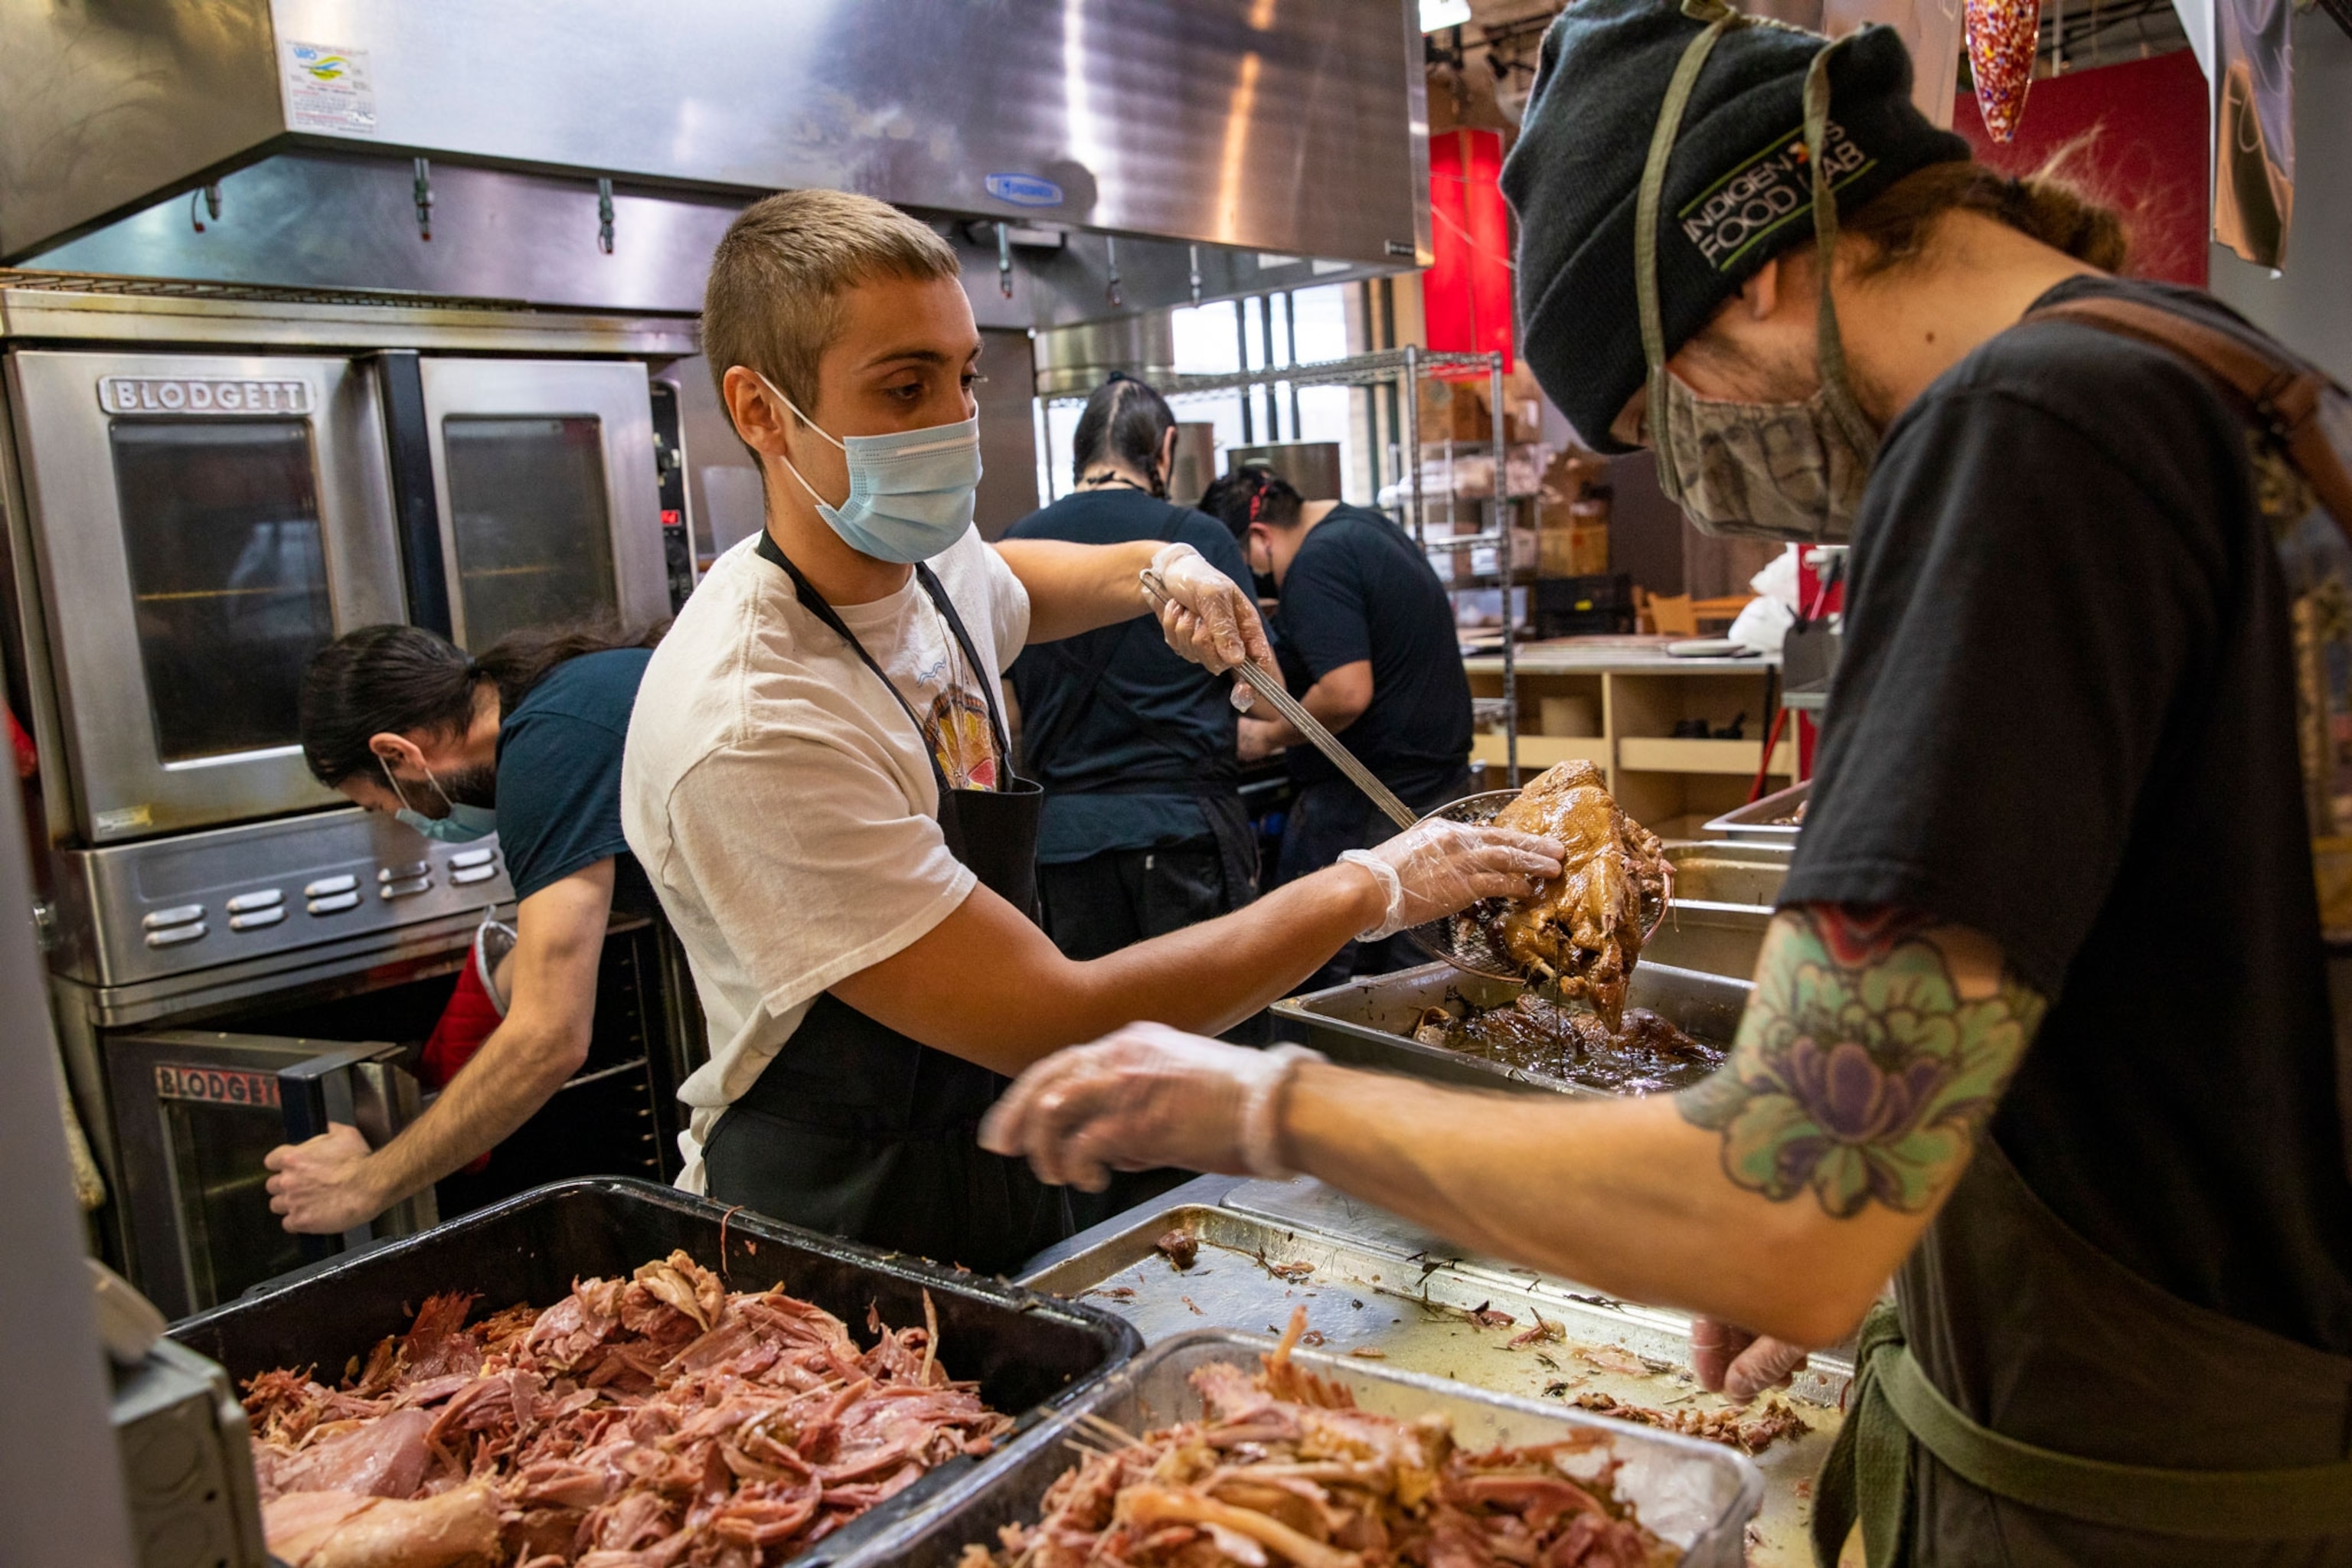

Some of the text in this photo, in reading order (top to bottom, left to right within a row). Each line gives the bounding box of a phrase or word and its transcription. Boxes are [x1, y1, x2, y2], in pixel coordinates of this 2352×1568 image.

[1682, 120, 1845, 244] INDIGENS
[1698, 185, 1798, 270] FOOD
[115, 381, 300, 410] BLODGETT
[159, 1067, 277, 1106] BLODGET
